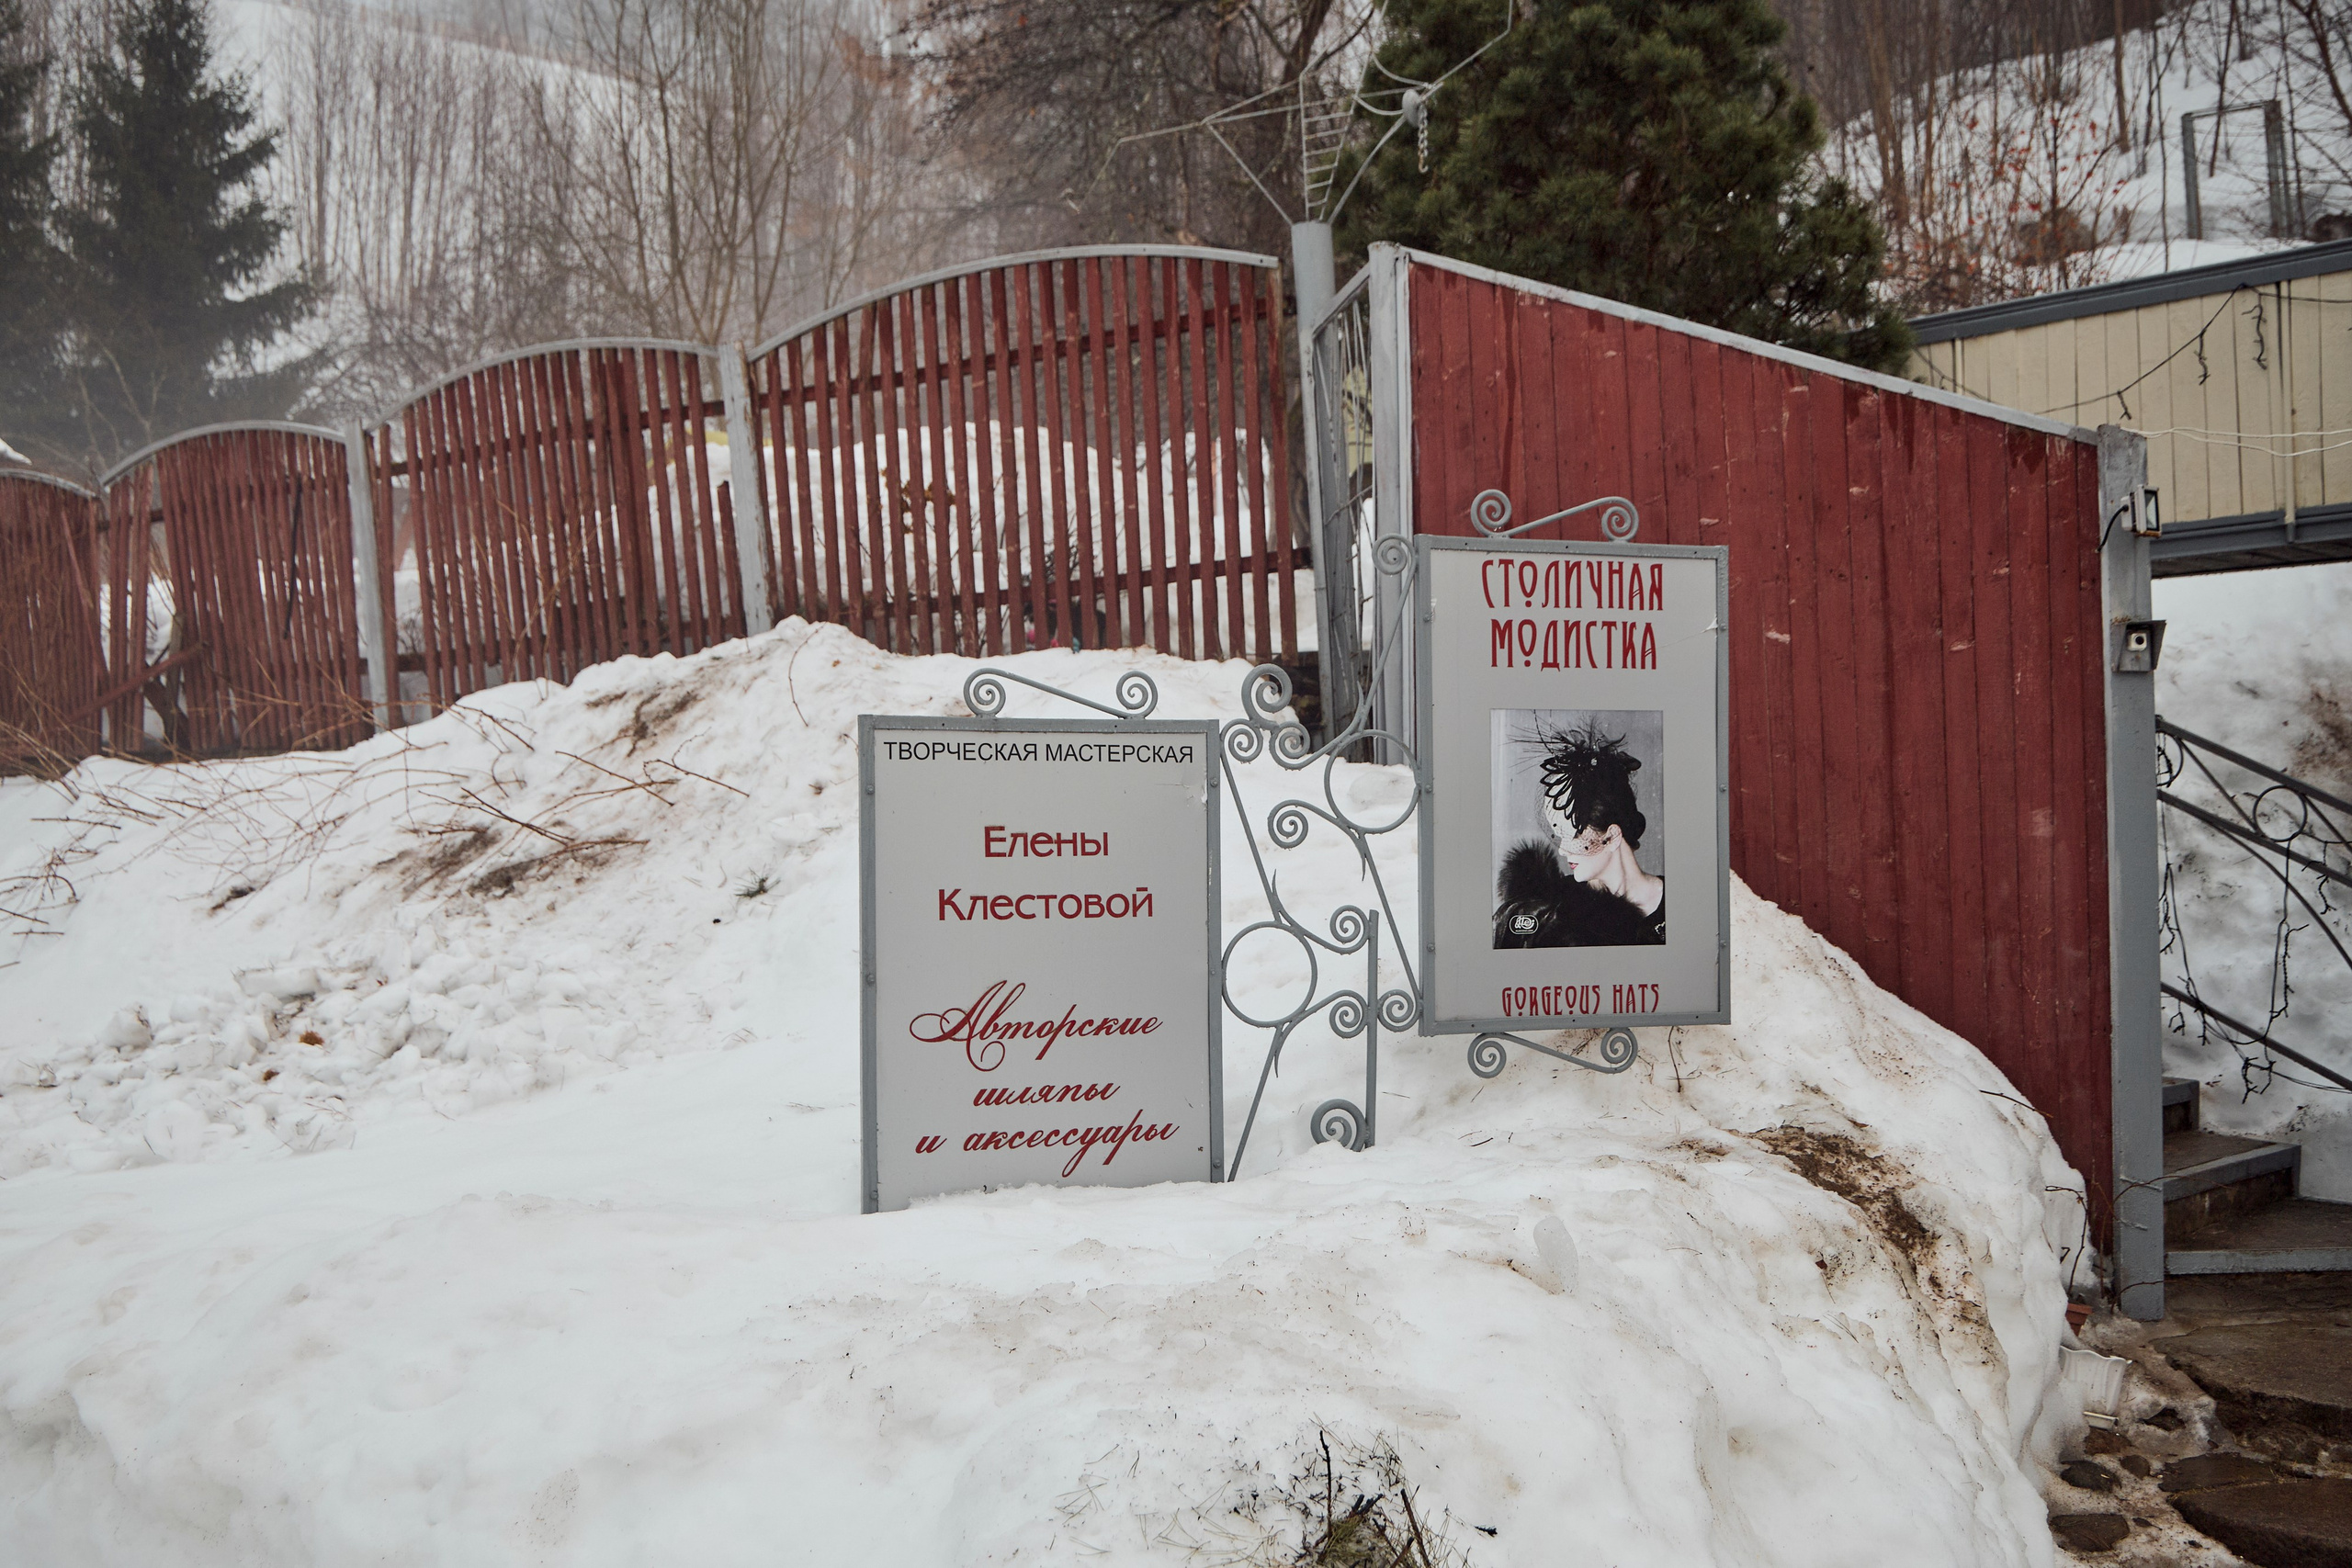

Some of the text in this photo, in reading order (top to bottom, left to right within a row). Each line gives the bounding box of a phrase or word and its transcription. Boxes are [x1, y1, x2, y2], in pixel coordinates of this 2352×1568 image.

[1481, 558, 1664, 612] СТОЛИЧНАЯ
[1490, 618, 1657, 671] МОДИСТКА
[883, 741, 1193, 764] ТВОРЧЕСКАЯ МАСТЕРСКАЯ
[984, 825, 1109, 858] Елены
[938, 886, 1153, 921] Клестовой
[1501, 983, 1660, 1017] GORGEOUS HATS
[909, 980, 1162, 1072] Авторские
[972, 1082, 1120, 1107] шляпы
[914, 1109, 1181, 1178] и аксессуары
